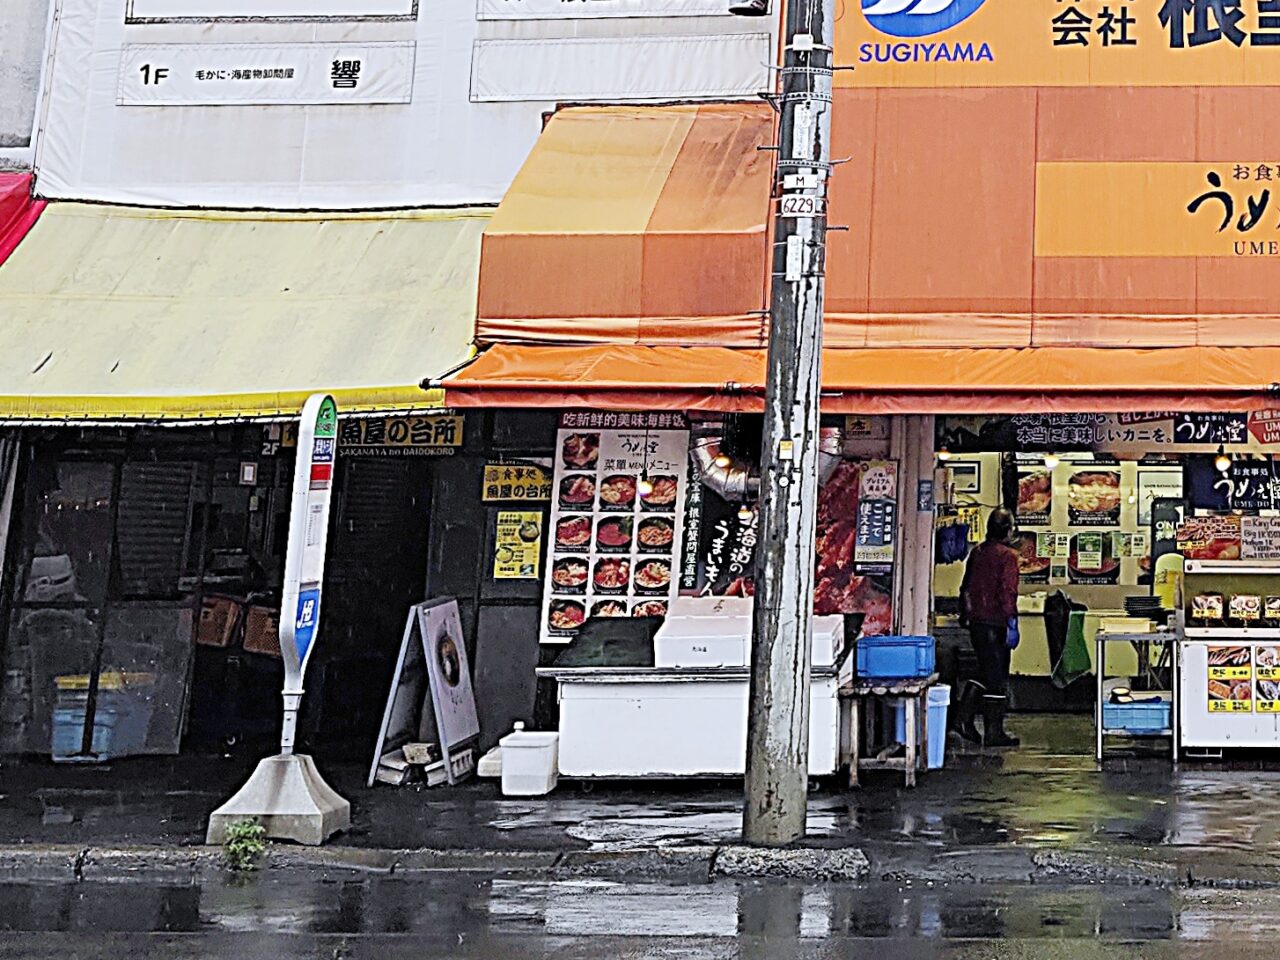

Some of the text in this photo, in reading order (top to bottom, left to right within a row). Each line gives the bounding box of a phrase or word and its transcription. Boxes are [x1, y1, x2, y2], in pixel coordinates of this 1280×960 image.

[859, 42, 994, 63] SUGIYAMA
[140, 64, 169, 85] 1F
[331, 60, 361, 88] 響
[783, 196, 815, 214] 6229
